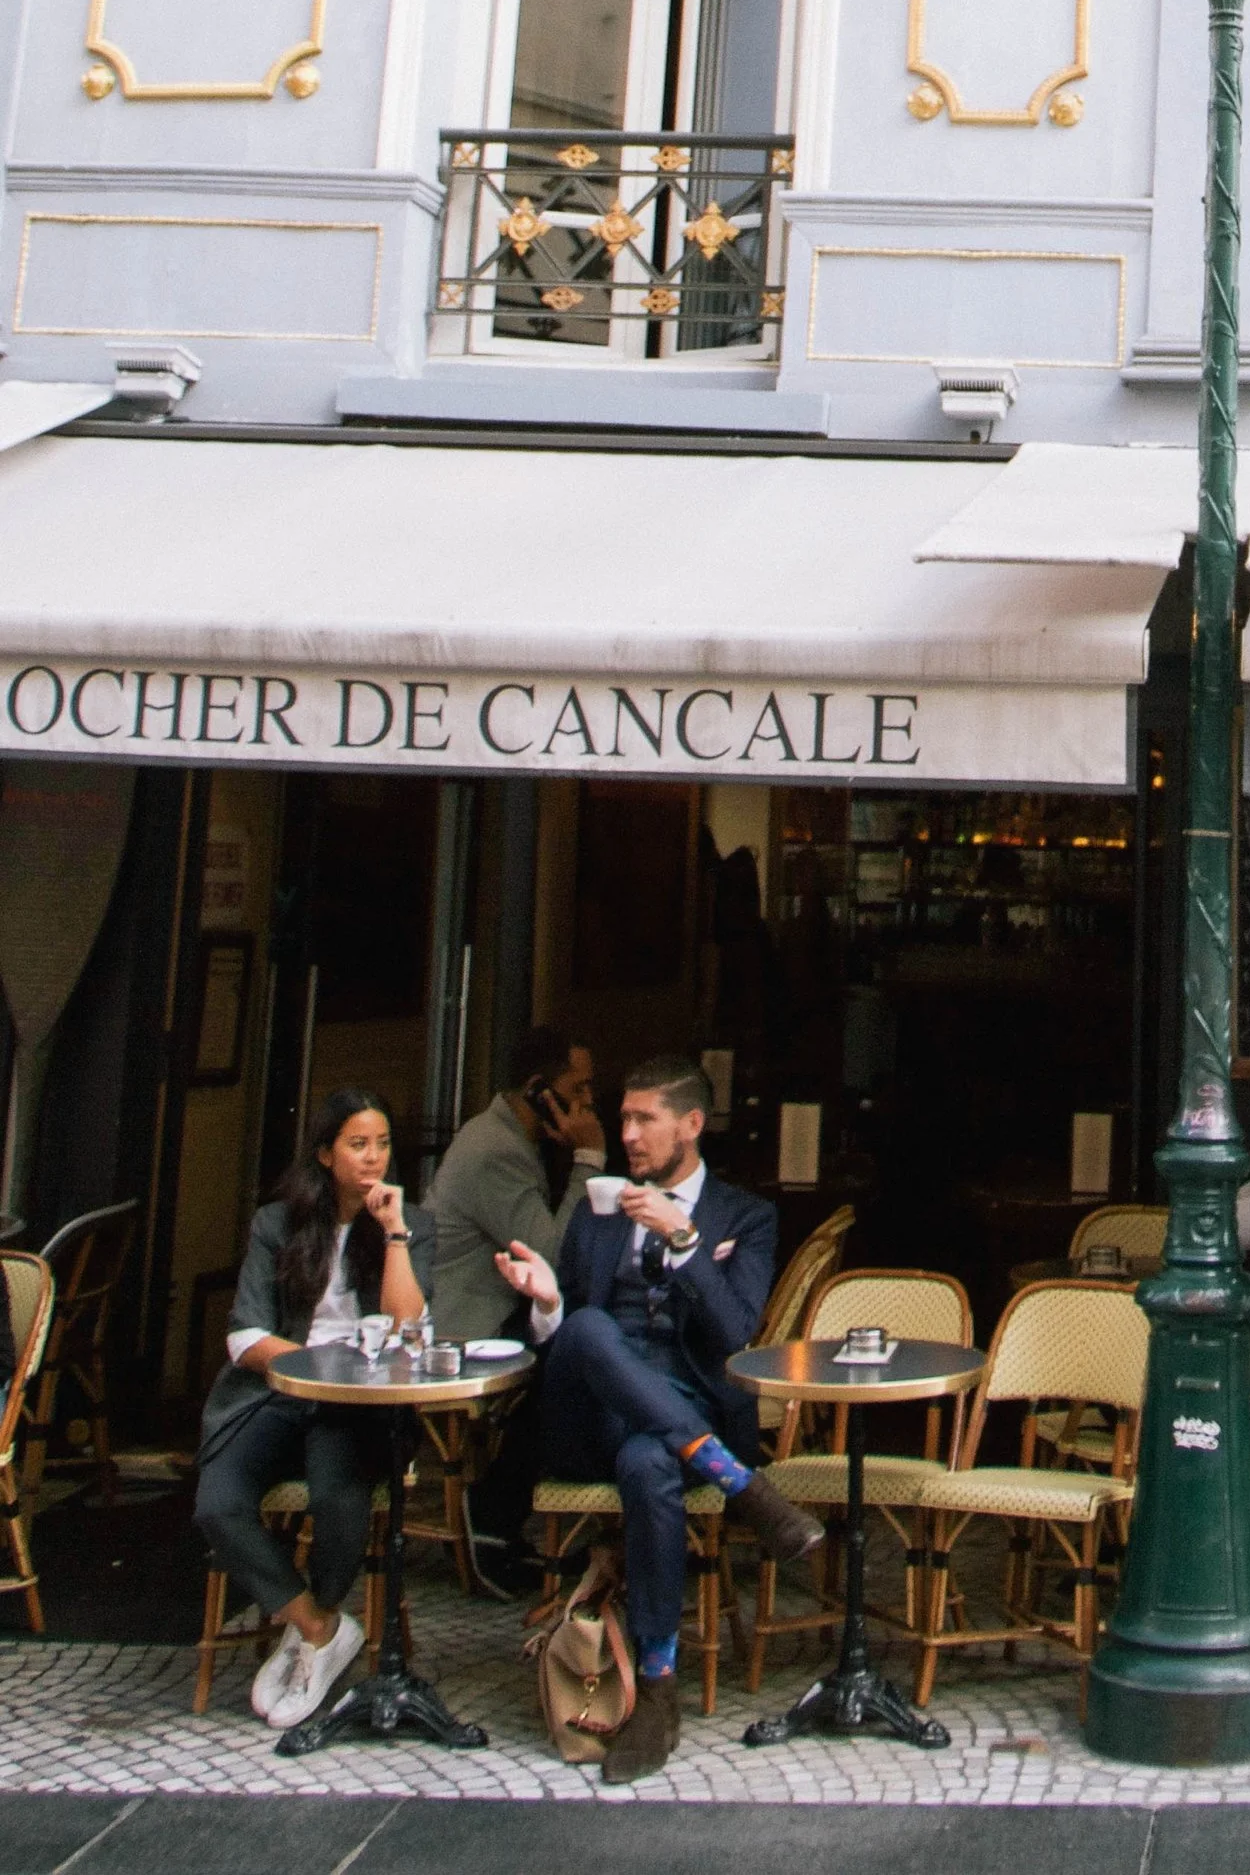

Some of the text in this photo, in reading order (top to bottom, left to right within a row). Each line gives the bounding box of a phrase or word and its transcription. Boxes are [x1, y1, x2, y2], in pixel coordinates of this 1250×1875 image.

[6, 665, 921, 766] OCHER DE CANCALE
